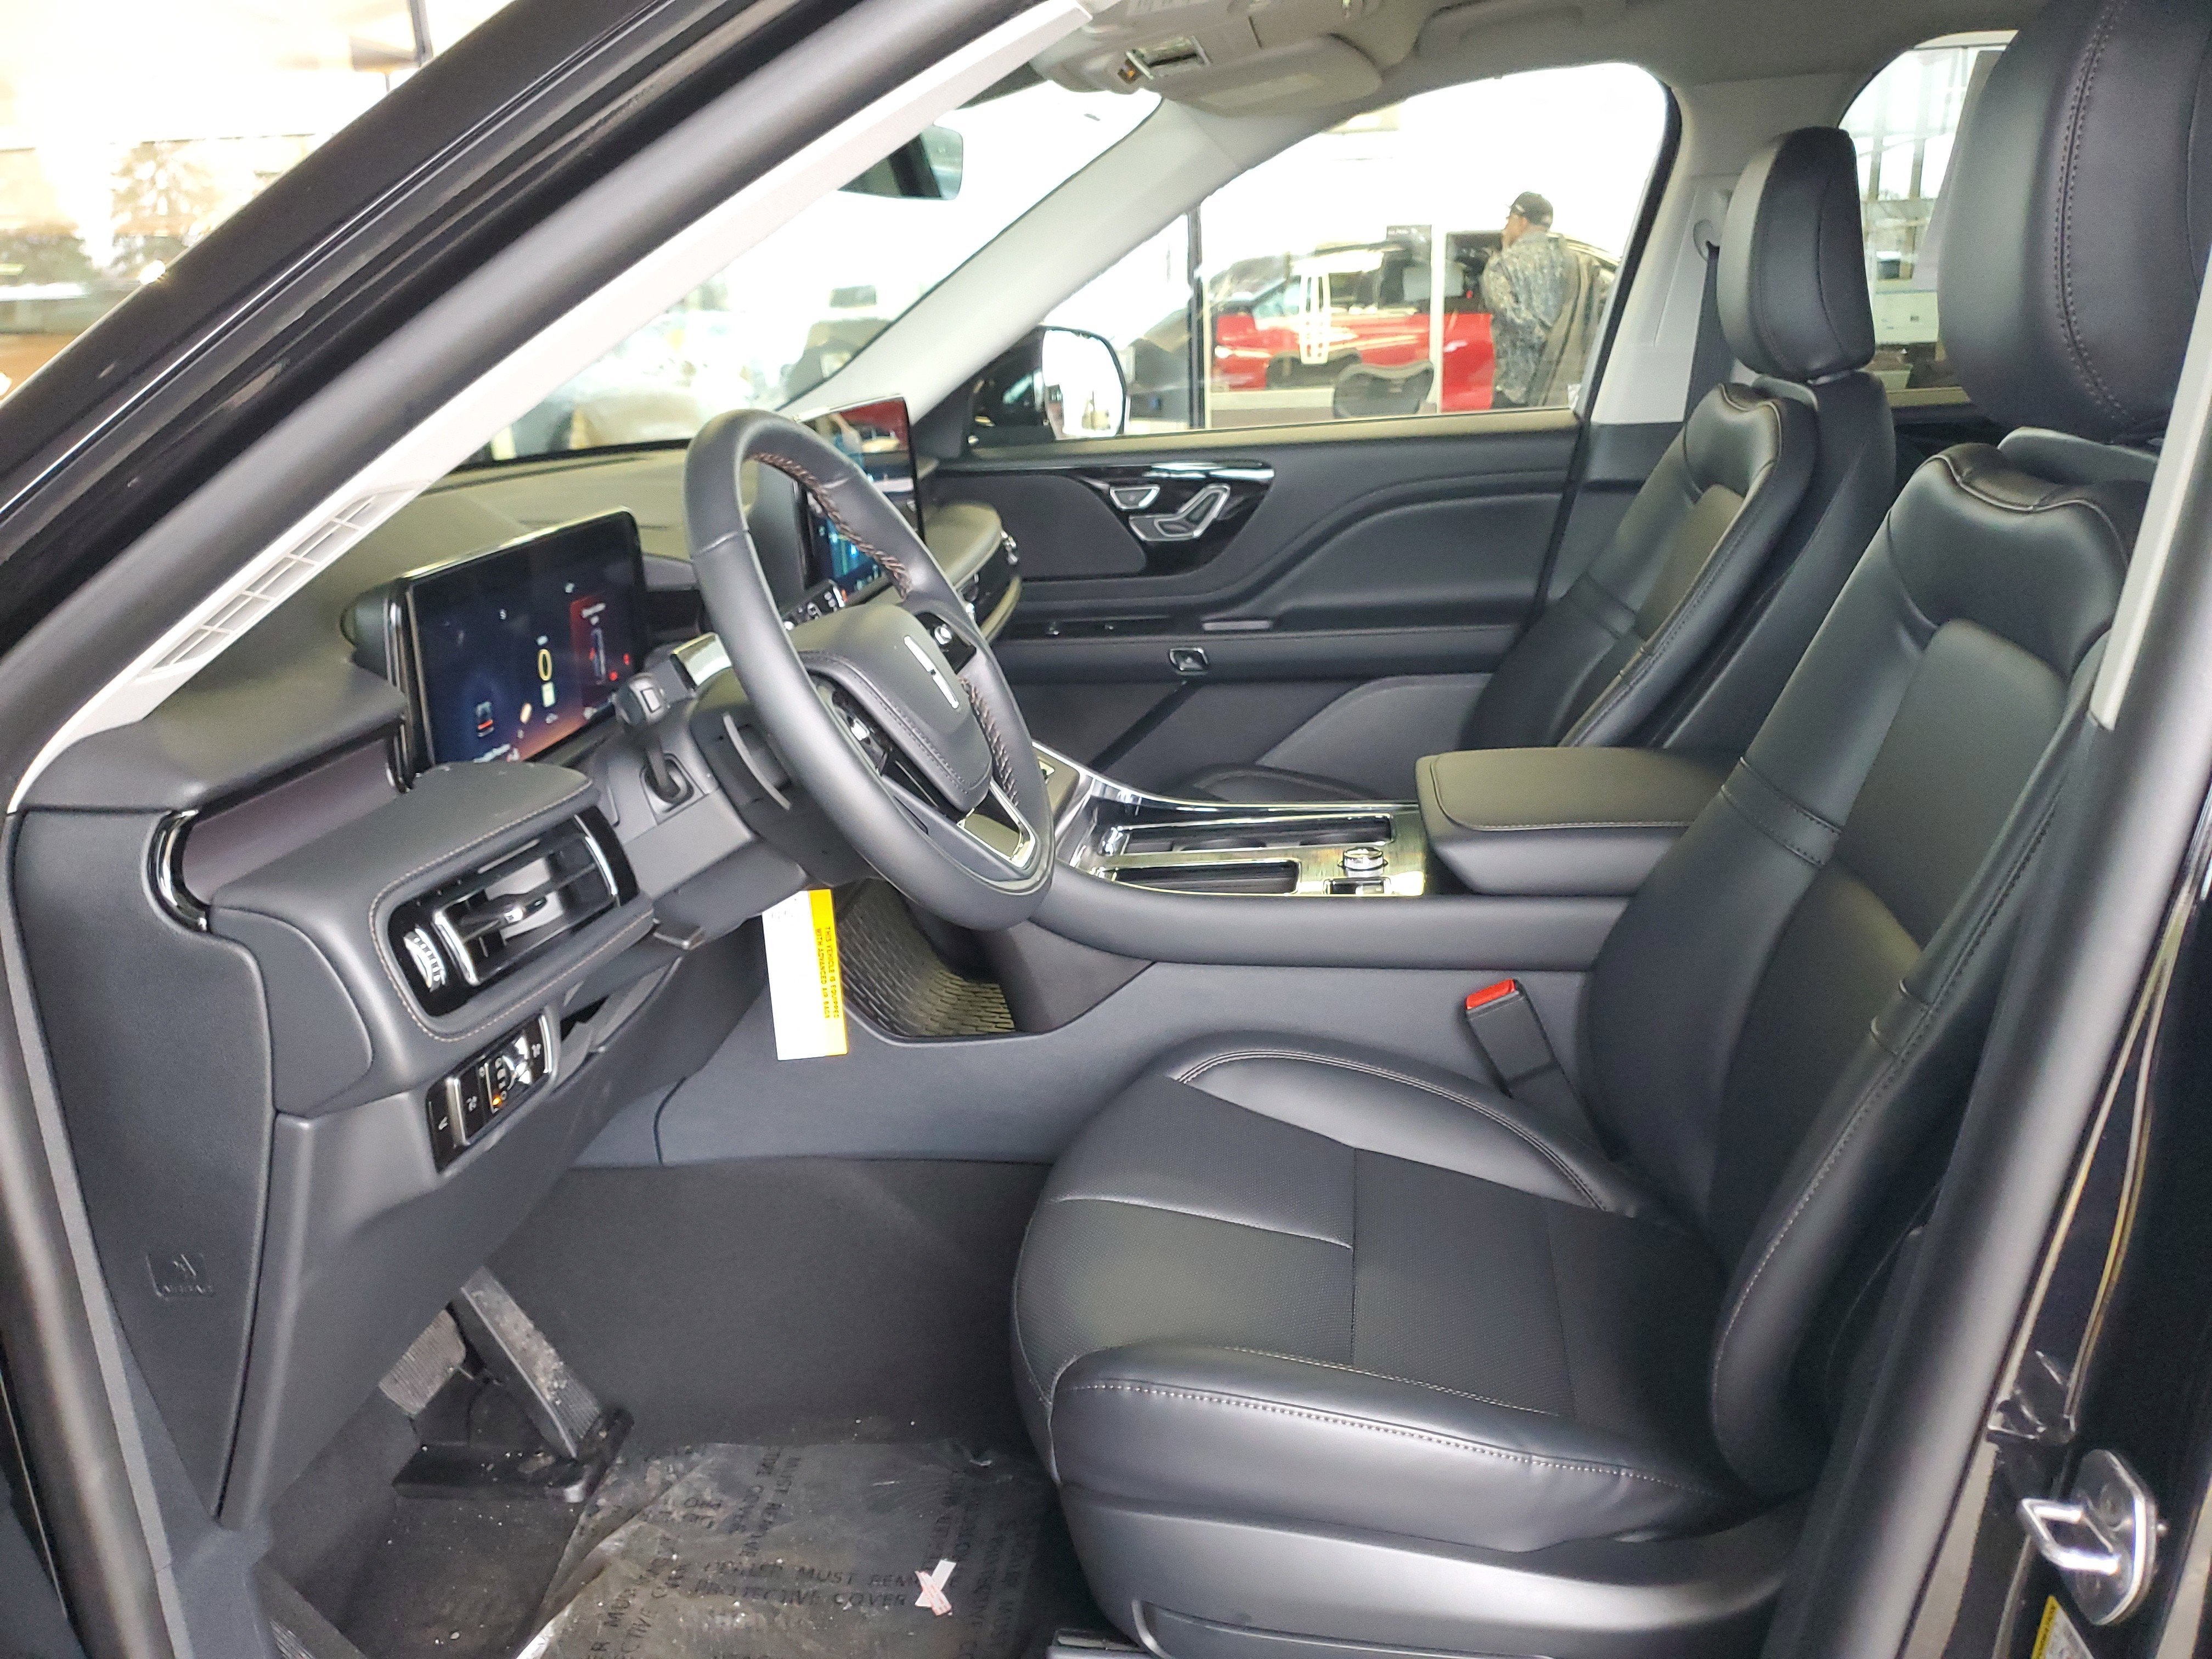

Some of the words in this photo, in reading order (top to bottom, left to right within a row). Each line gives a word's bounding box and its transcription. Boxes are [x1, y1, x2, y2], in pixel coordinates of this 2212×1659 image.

[817, 947, 827, 985] ADVANCED
[827, 945, 835, 973] VEHICLE
[831, 984, 840, 1019] EQUIPPED
[797, 1565, 859, 1585] MUST
[693, 1578, 822, 1605] PROTECTIVE
[833, 1592, 906, 1606] COVER
